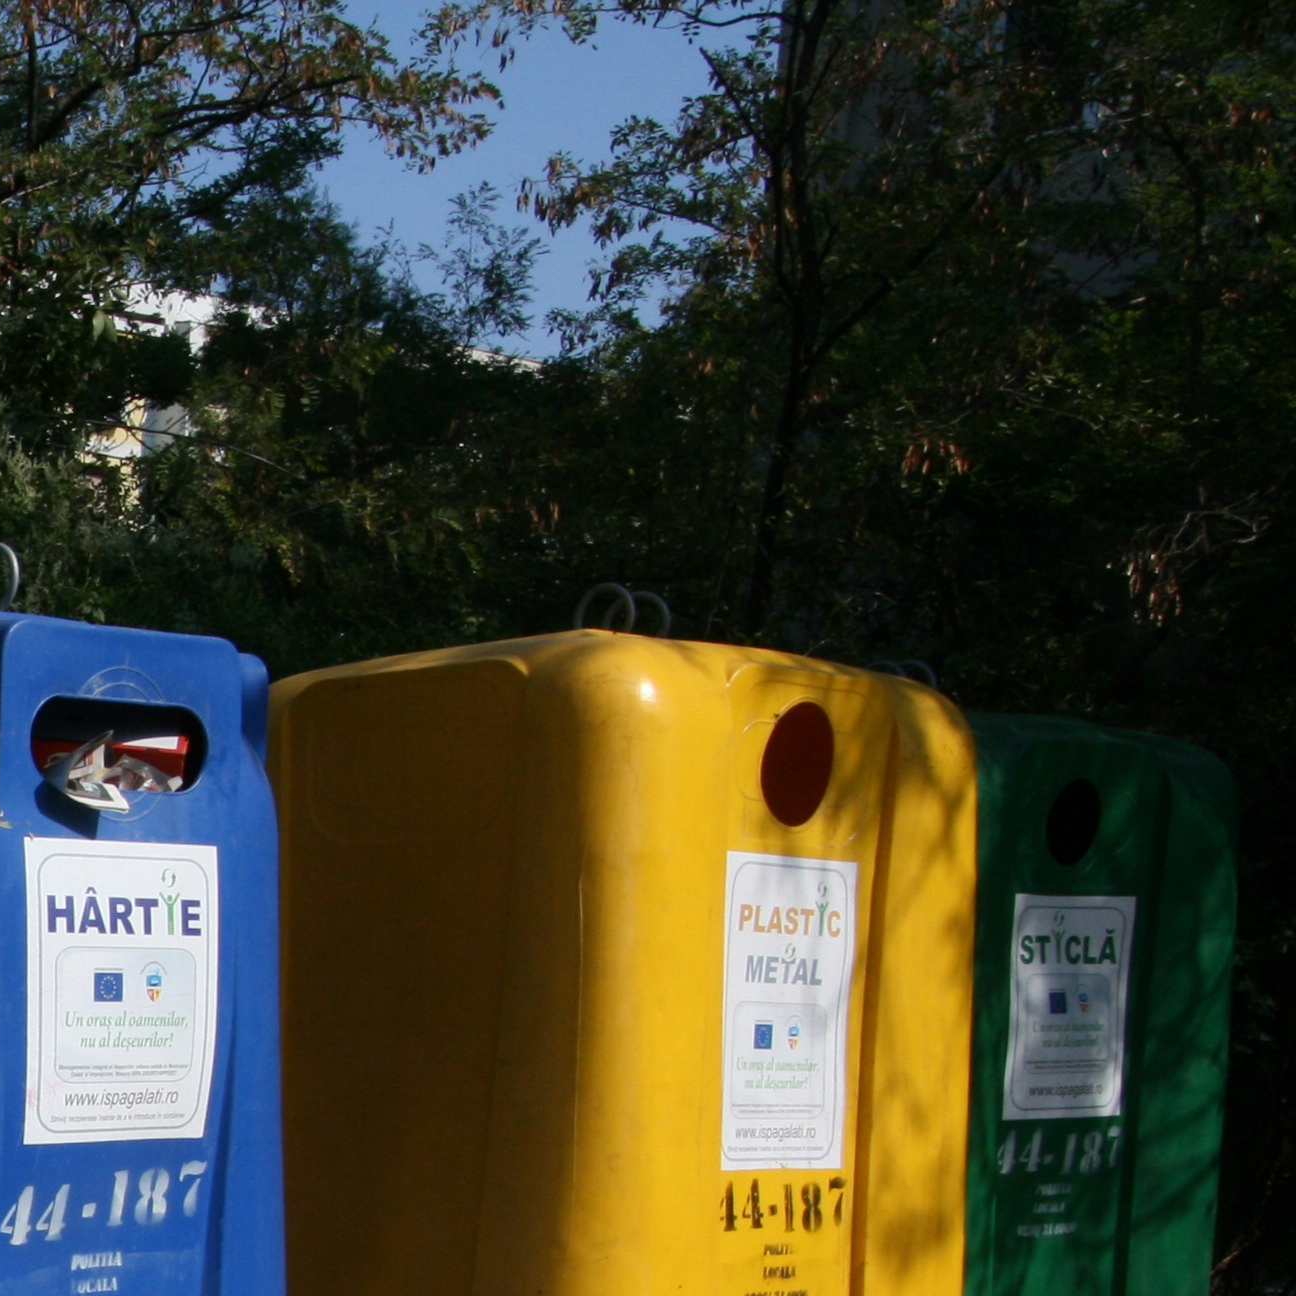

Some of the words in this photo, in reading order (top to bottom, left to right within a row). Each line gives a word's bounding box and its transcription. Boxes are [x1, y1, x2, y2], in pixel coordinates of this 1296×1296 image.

[745, 954, 822, 986] METAL
[64, 1011, 83, 1027] Un
[114, 1010, 127, 1027] al
[128, 1010, 188, 1029] oamenilor,
[80, 1036, 96, 1048] nu
[98, 1031, 112, 1048] al
[64, 1088, 179, 1109] www.ispagalati.ro
[0, 1160, 208, 1245] 44-187
[719, 1176, 847, 1233] 44-187
